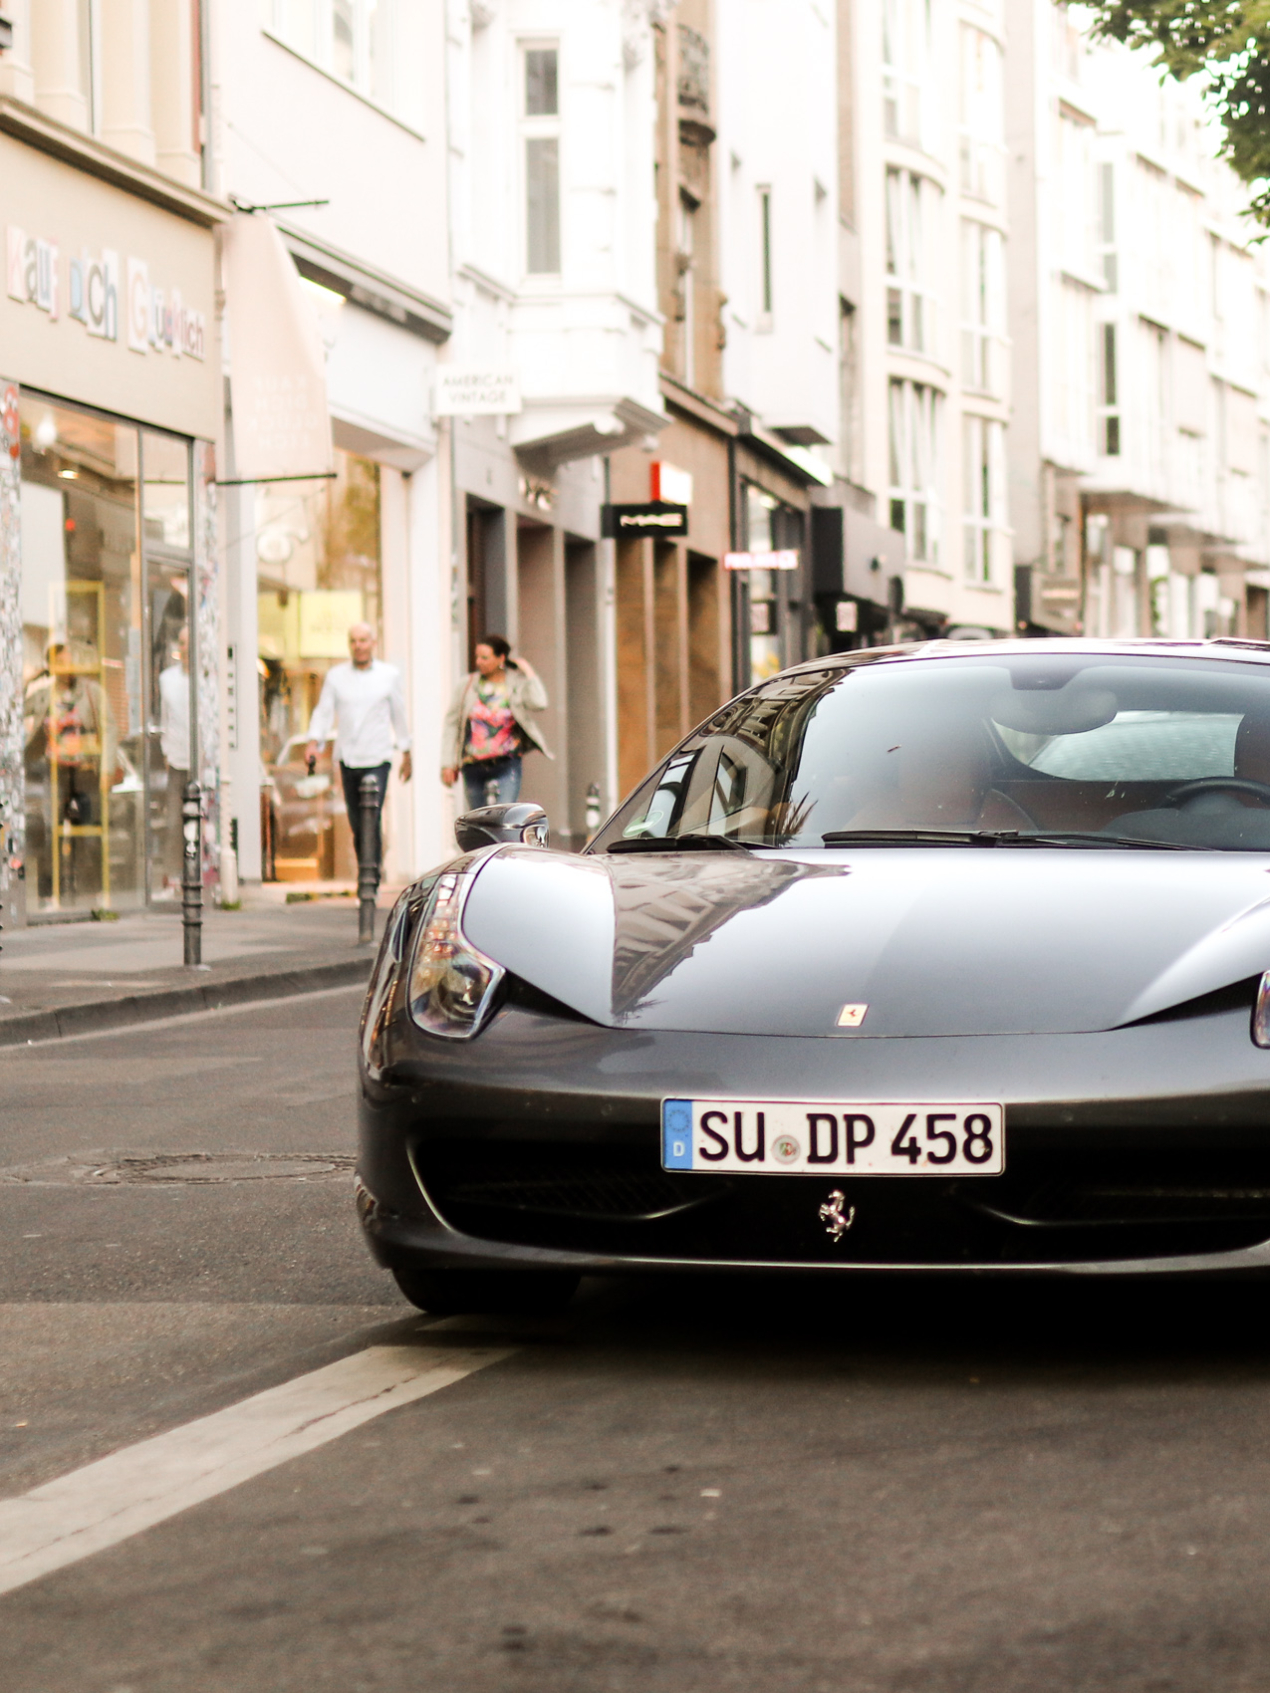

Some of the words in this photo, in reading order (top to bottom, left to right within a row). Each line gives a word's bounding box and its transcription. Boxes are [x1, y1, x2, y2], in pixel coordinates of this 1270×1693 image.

[673, 1141, 685, 1157] D
[699, 1111, 765, 1162] SU
[806, 1113, 876, 1165] DP
[891, 1113, 994, 1165] 458
